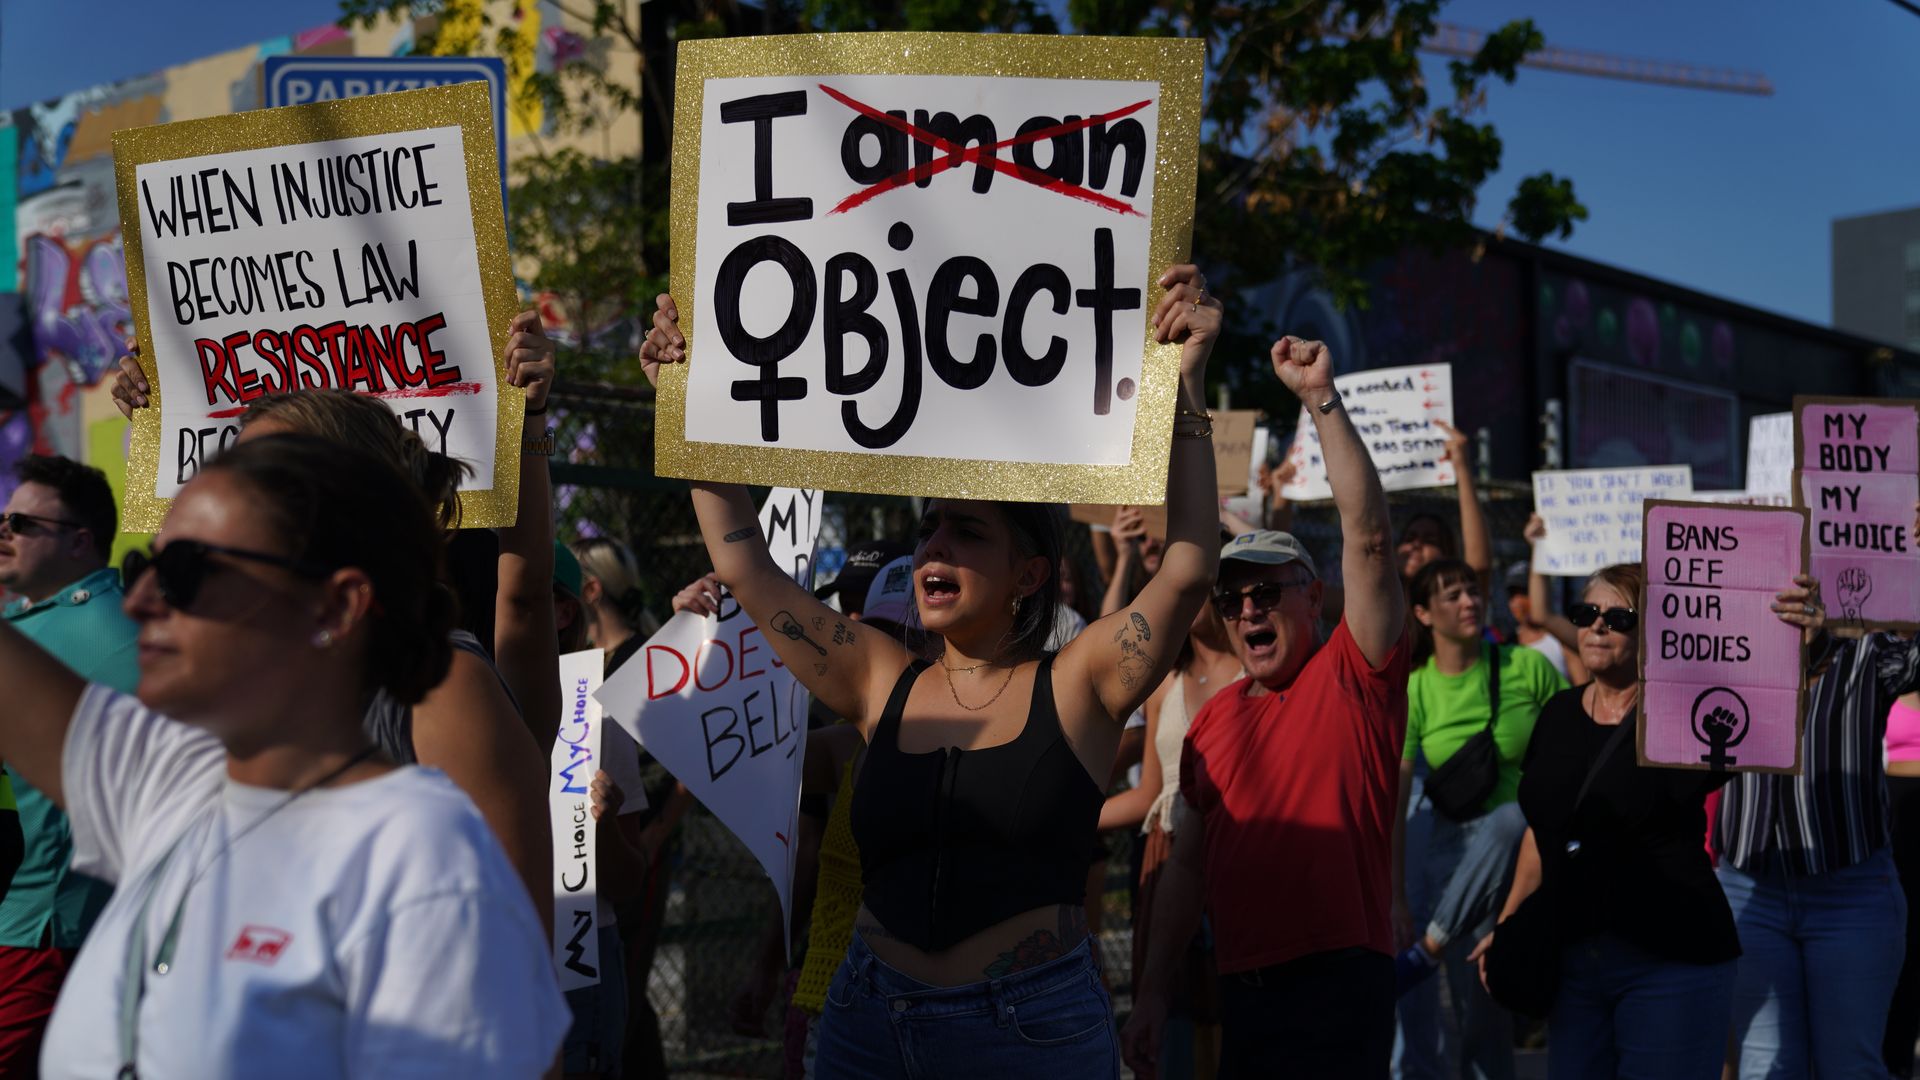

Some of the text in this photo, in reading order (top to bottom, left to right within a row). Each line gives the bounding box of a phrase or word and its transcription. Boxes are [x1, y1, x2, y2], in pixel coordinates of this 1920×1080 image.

[719, 89, 814, 226] I
[141, 143, 443, 239] WHEN INJUSTICE
[166, 239, 420, 326] BECOMES LAW
[194, 312, 462, 405] RESISTANCE
[1824, 413, 1867, 440] MY
[1819, 443, 1891, 473] BODY
[1821, 485, 1861, 512] MY
[767, 488, 816, 548] MY
[1666, 522, 1739, 551] BANS
[1817, 520, 1907, 553] CHOICE
[1664, 557, 1724, 583] OFF
[1662, 593, 1722, 621] OUR
[1661, 629, 1751, 662] BODIES
[646, 626, 785, 701] DOE
[561, 801, 589, 893] CHOICE
